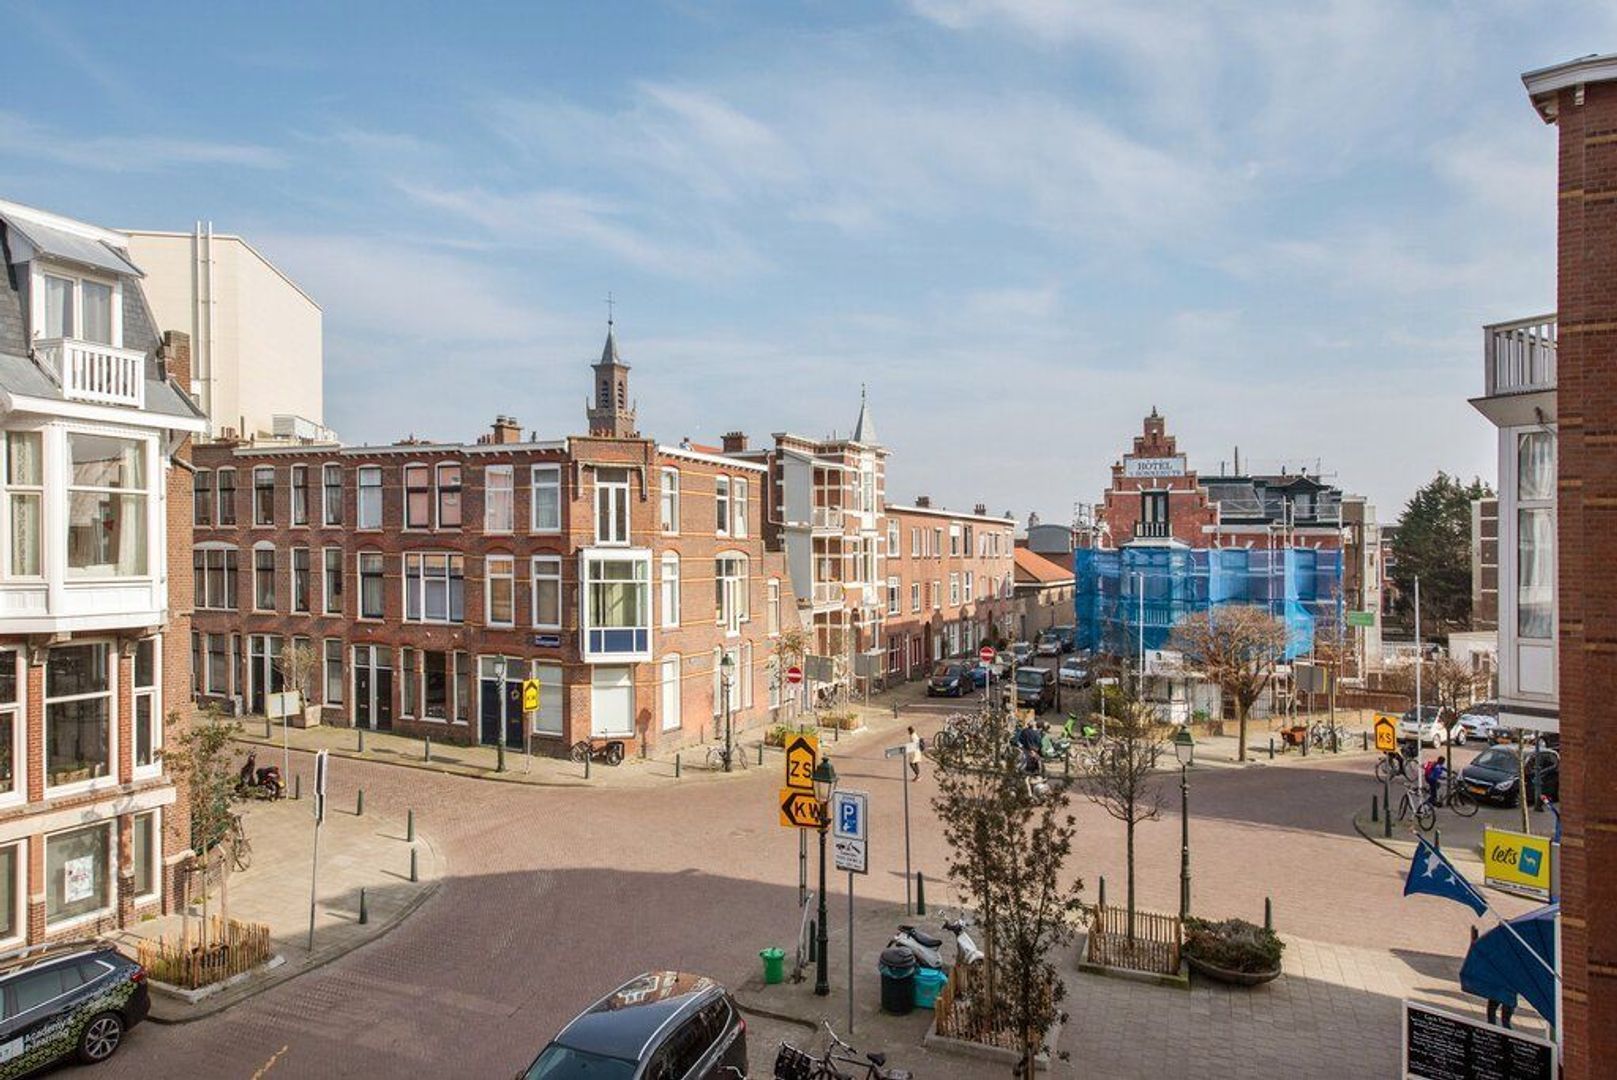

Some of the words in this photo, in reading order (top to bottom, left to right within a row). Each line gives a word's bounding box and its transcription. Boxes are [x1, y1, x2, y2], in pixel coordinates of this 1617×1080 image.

[1137, 462, 1172, 471] HOTEL
[1378, 732, 1392, 744] KS
[790, 760, 811, 778] ZS
[843, 805, 854, 820] P
